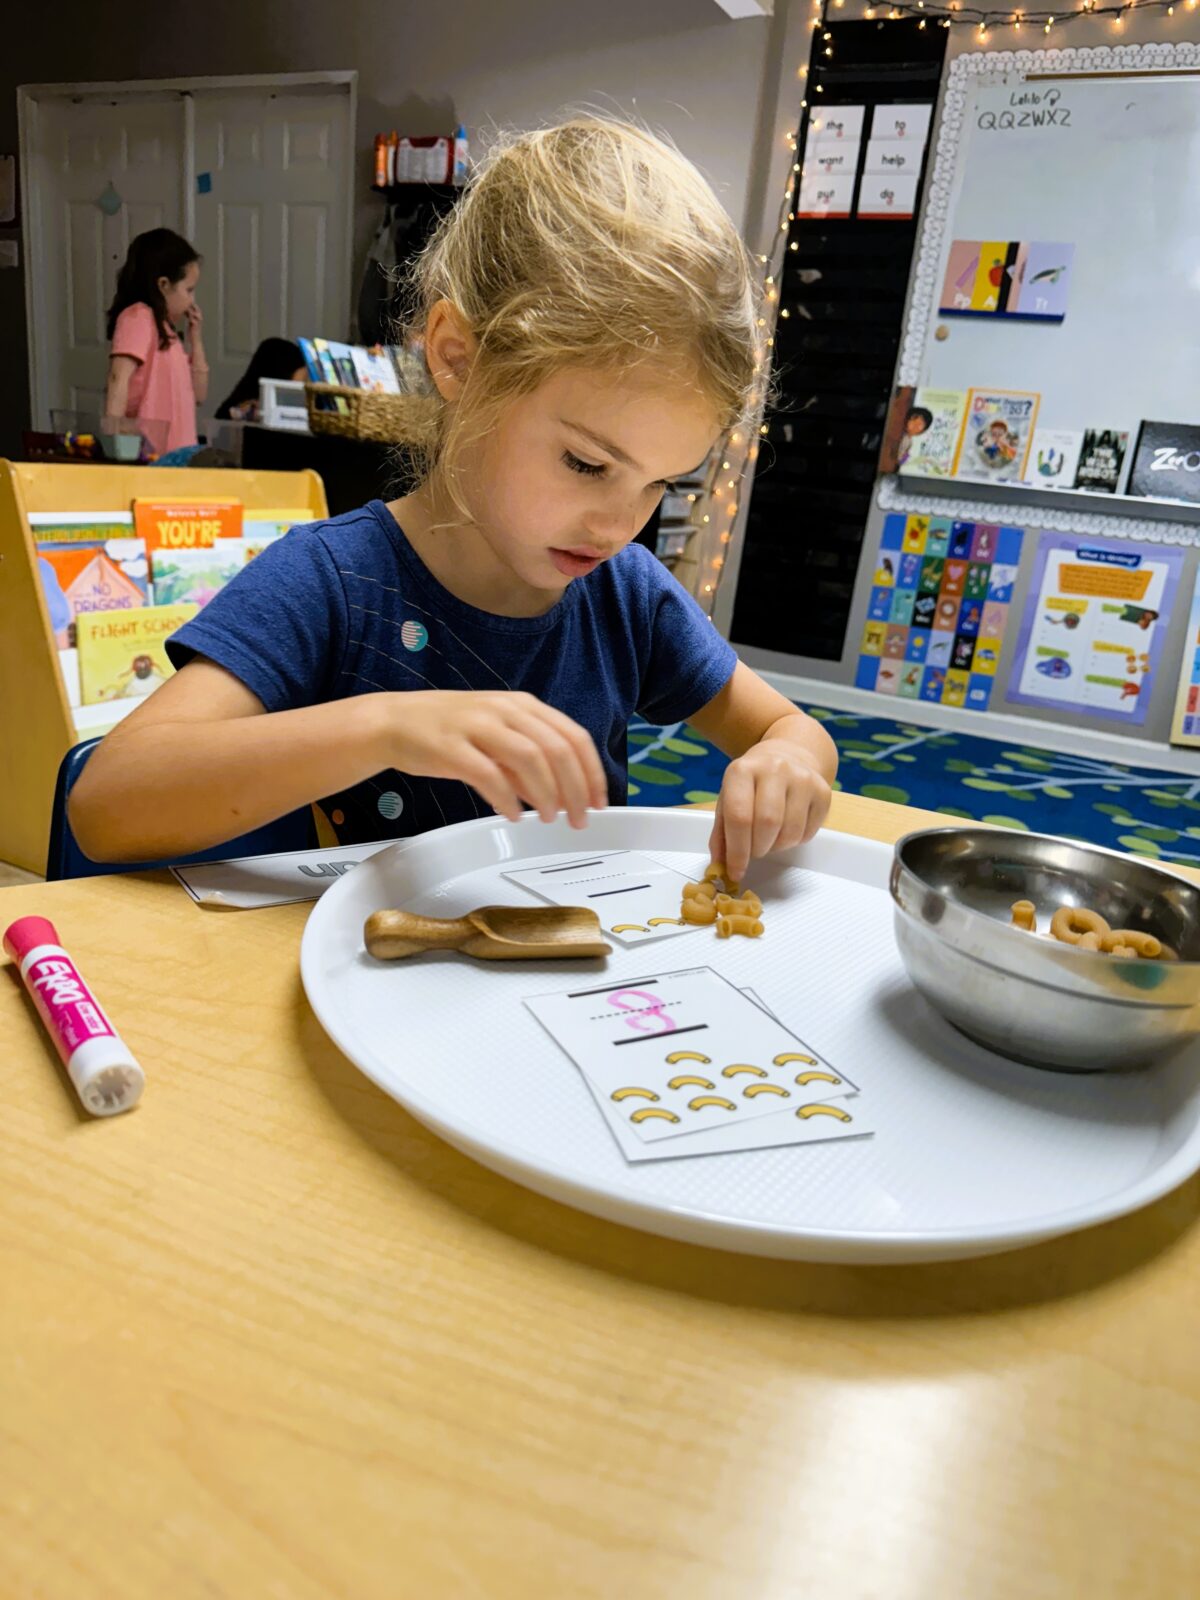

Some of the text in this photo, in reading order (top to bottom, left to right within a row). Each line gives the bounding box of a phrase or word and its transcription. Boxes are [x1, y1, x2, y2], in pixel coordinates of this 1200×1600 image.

[827, 120, 844, 130] the
[895, 120, 906, 130] to
[818, 156, 844, 165] want
[881, 154, 905, 166] help
[817, 189, 835, 200] put
[880, 188, 894, 199] do
[1093, 447, 1114, 459] THE
[157, 519, 223, 547] YOU'RE
[93, 581, 112, 598] NO
[74, 596, 133, 613] DRAGONS
[90, 620, 139, 640] FLIGHT
